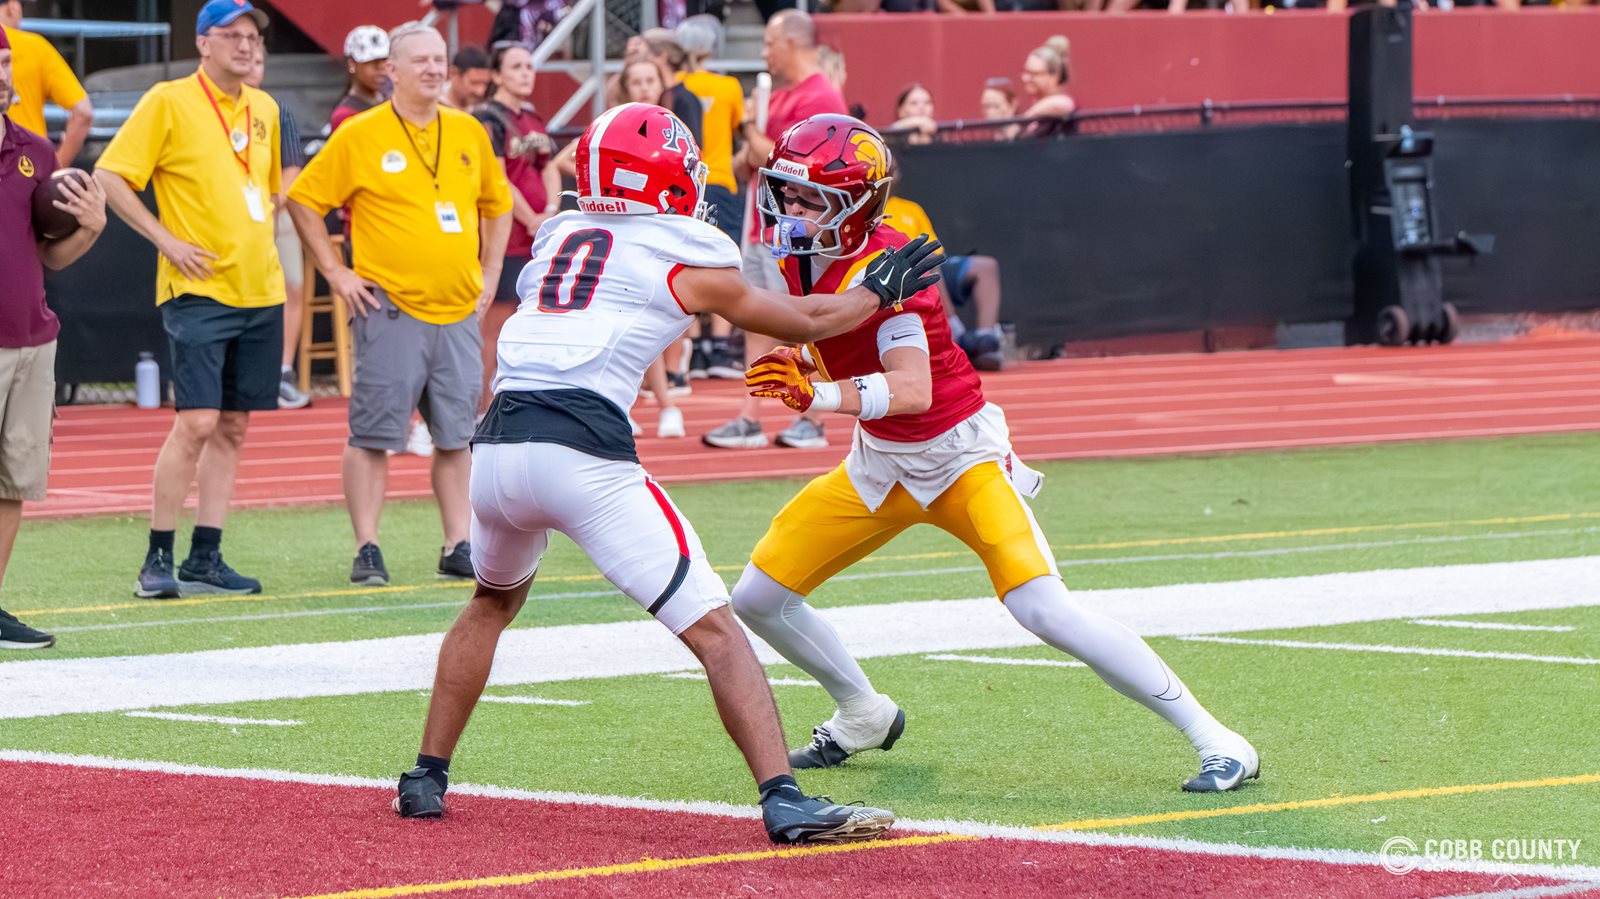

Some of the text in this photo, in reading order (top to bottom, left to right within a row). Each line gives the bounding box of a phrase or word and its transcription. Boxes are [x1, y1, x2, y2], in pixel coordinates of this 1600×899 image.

[774, 162, 805, 177] Riddell
[579, 200, 628, 213] Riddell
[537, 228, 613, 314] 0
